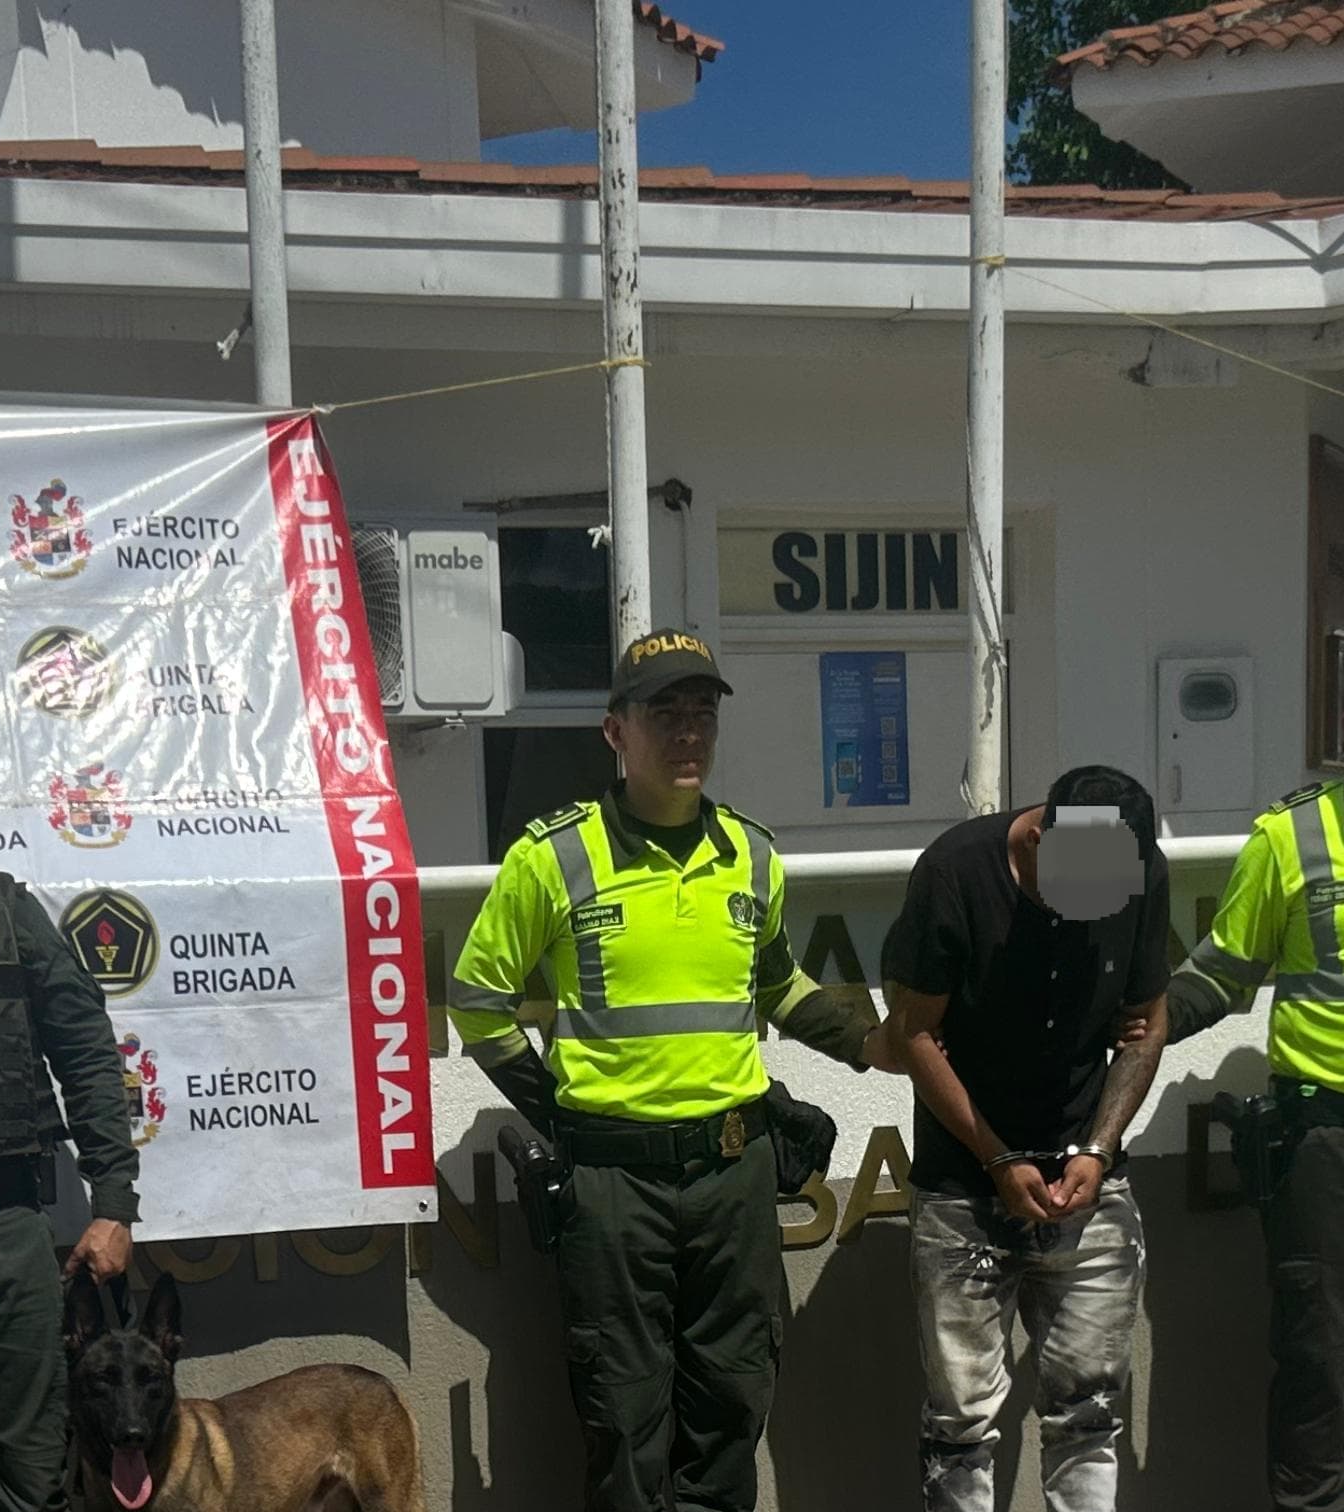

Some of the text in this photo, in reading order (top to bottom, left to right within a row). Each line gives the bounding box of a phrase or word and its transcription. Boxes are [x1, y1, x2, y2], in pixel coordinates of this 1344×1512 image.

[113, 511, 240, 540] EJÉRCITO
[117, 547, 245, 571] NACIONAL
[415, 547, 484, 571] mabe
[772, 531, 958, 612] SIJIN
[288, 438, 373, 775] EJÉRCITO
[146, 664, 227, 688] UINTA
[158, 817, 290, 838] NACIONAL
[170, 932, 269, 959] QUINTA
[172, 966, 296, 995] BRIGADA
[346, 797, 416, 1175] NACIONAL
[187, 1067, 317, 1098] EJÉRCITO
[190, 1102, 319, 1131] NACIONAL
